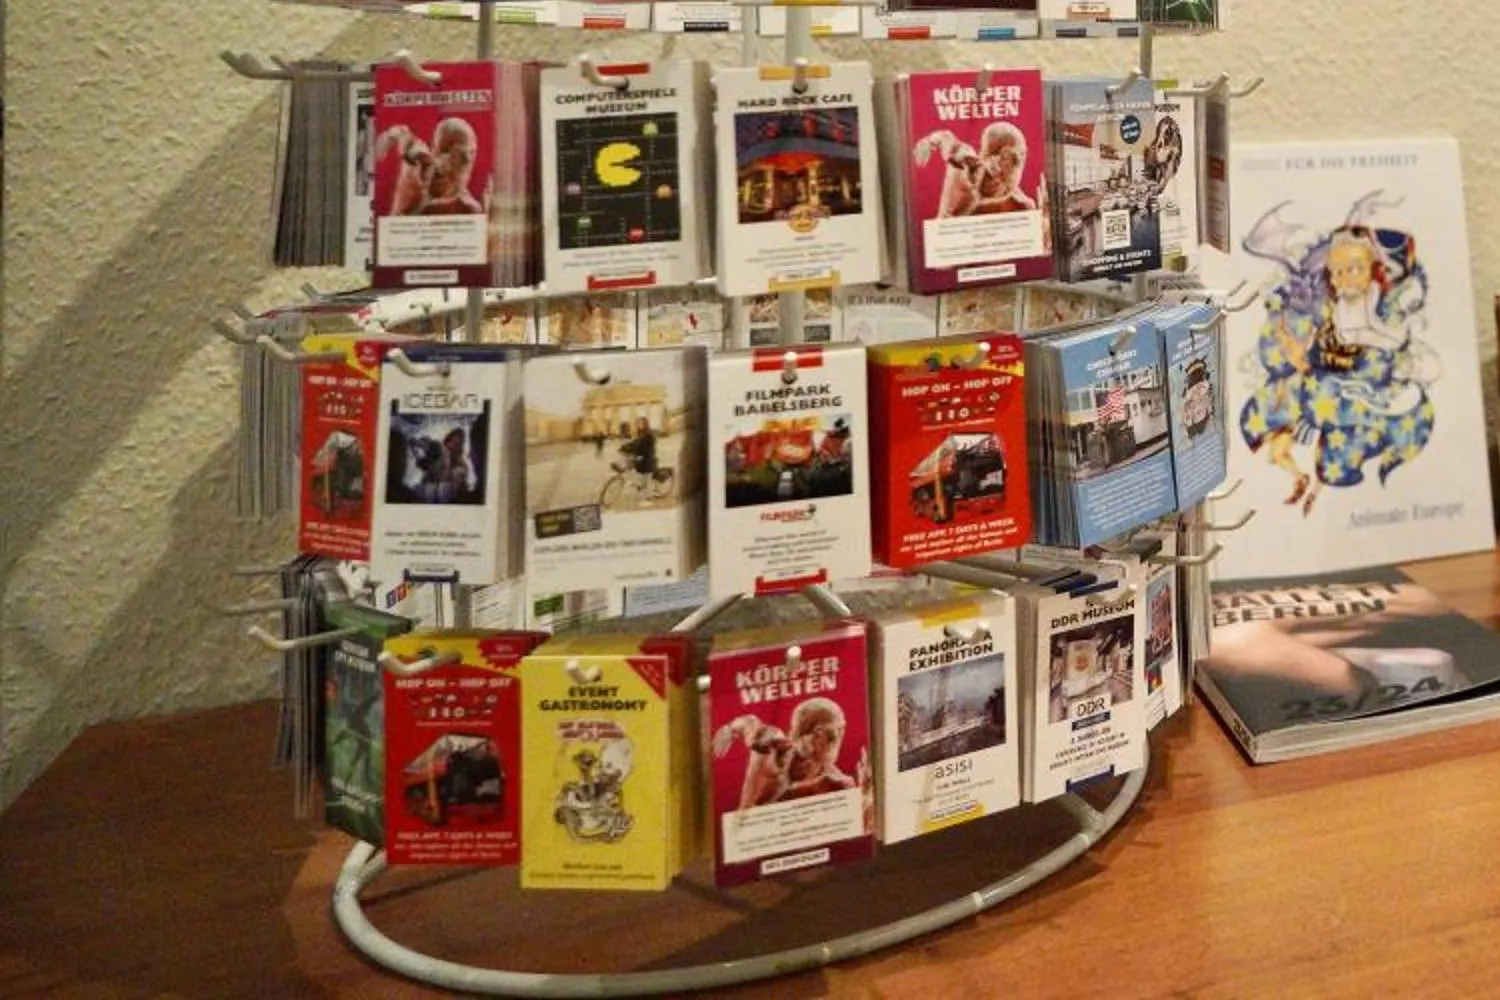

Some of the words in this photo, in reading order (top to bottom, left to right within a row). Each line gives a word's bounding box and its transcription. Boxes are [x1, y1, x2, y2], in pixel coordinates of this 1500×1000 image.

[555, 87, 678, 105] COMPUTERSPIELE
[737, 96, 777, 109] HARD
[782, 94, 818, 106] ROCK
[821, 93, 853, 104] CAFE
[933, 83, 1022, 105] KÖRPER
[585, 100, 648, 115] MUSEUM
[937, 101, 1020, 121] WELTEN
[744, 383, 831, 402] FILMPARK
[902, 383, 929, 397] HOP
[932, 382, 951, 394] ON
[964, 377, 989, 390] HOP
[992, 375, 1013, 387] OFF
[402, 392, 480, 408] ICEBAR
[735, 395, 843, 417] BABELSBERG
[1051, 613, 1079, 628] DDR
[1081, 599, 1135, 622] MUSEUM
[1212, 598, 1386, 628] BERLIN
[909, 642, 994, 671] EXHIBITION
[735, 655, 841, 688] KÖRPER
[568, 685, 619, 699] EVENT
[740, 674, 838, 706] WELTEN
[539, 699, 648, 713] GASTRONOMY
[1076, 697, 1106, 716] DDR
[934, 759, 974, 779] asisi
